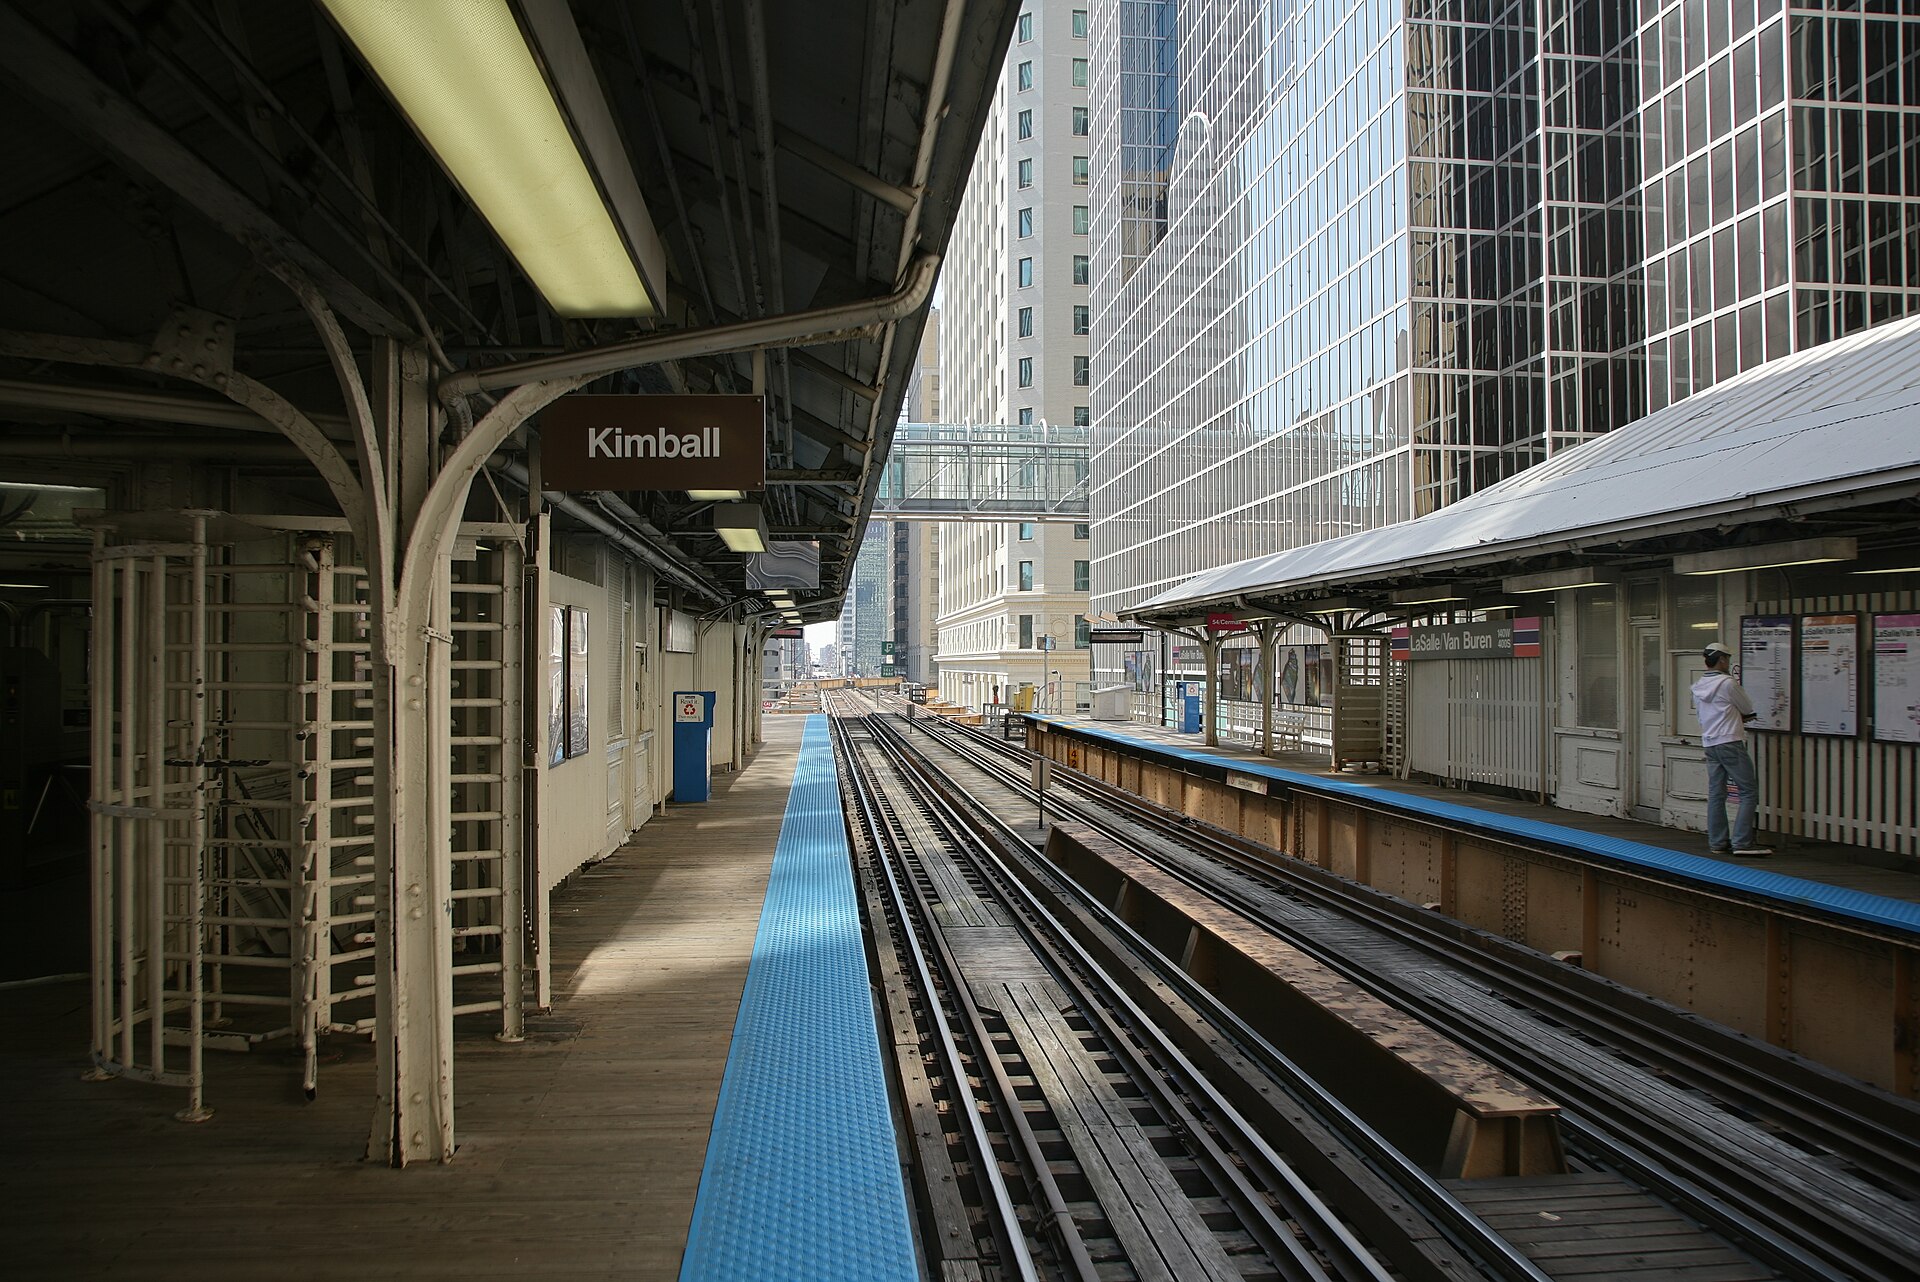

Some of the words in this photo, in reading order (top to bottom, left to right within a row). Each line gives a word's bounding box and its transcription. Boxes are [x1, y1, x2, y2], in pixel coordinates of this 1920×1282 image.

[588, 427, 720, 458] Kimball
[1410, 632, 1460, 651] LaSalle/Van
[1463, 630, 1492, 650] Buren
[1497, 639, 1511, 649] 400S
